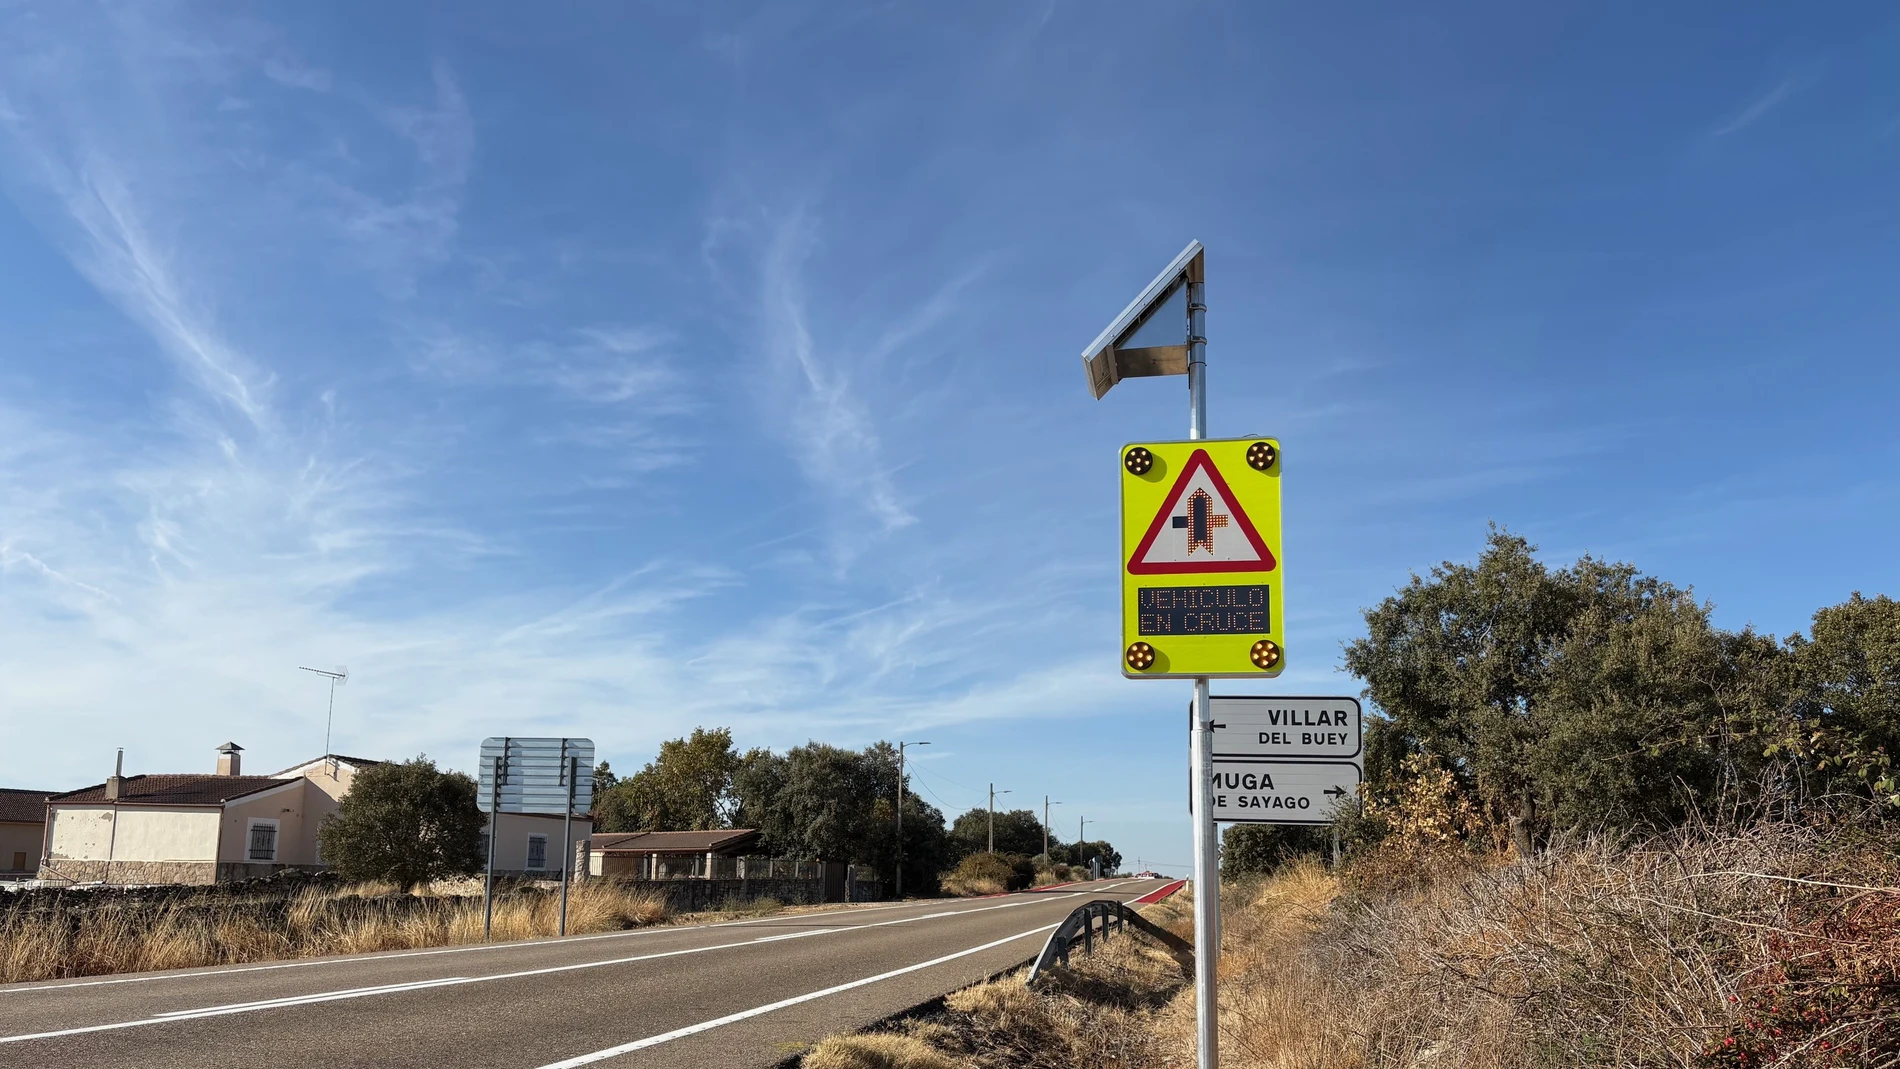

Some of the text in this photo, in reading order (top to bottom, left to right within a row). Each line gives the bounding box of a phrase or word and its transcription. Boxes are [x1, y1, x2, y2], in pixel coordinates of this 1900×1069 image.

[1141, 588, 1263, 609] VEHICULO
[1141, 611, 1264, 632] EN CRUCE
[1268, 709, 1348, 726] VILLAR
[1258, 732, 1348, 745] DEL BUEY
[1212, 795, 1310, 810] E SAYAGO
